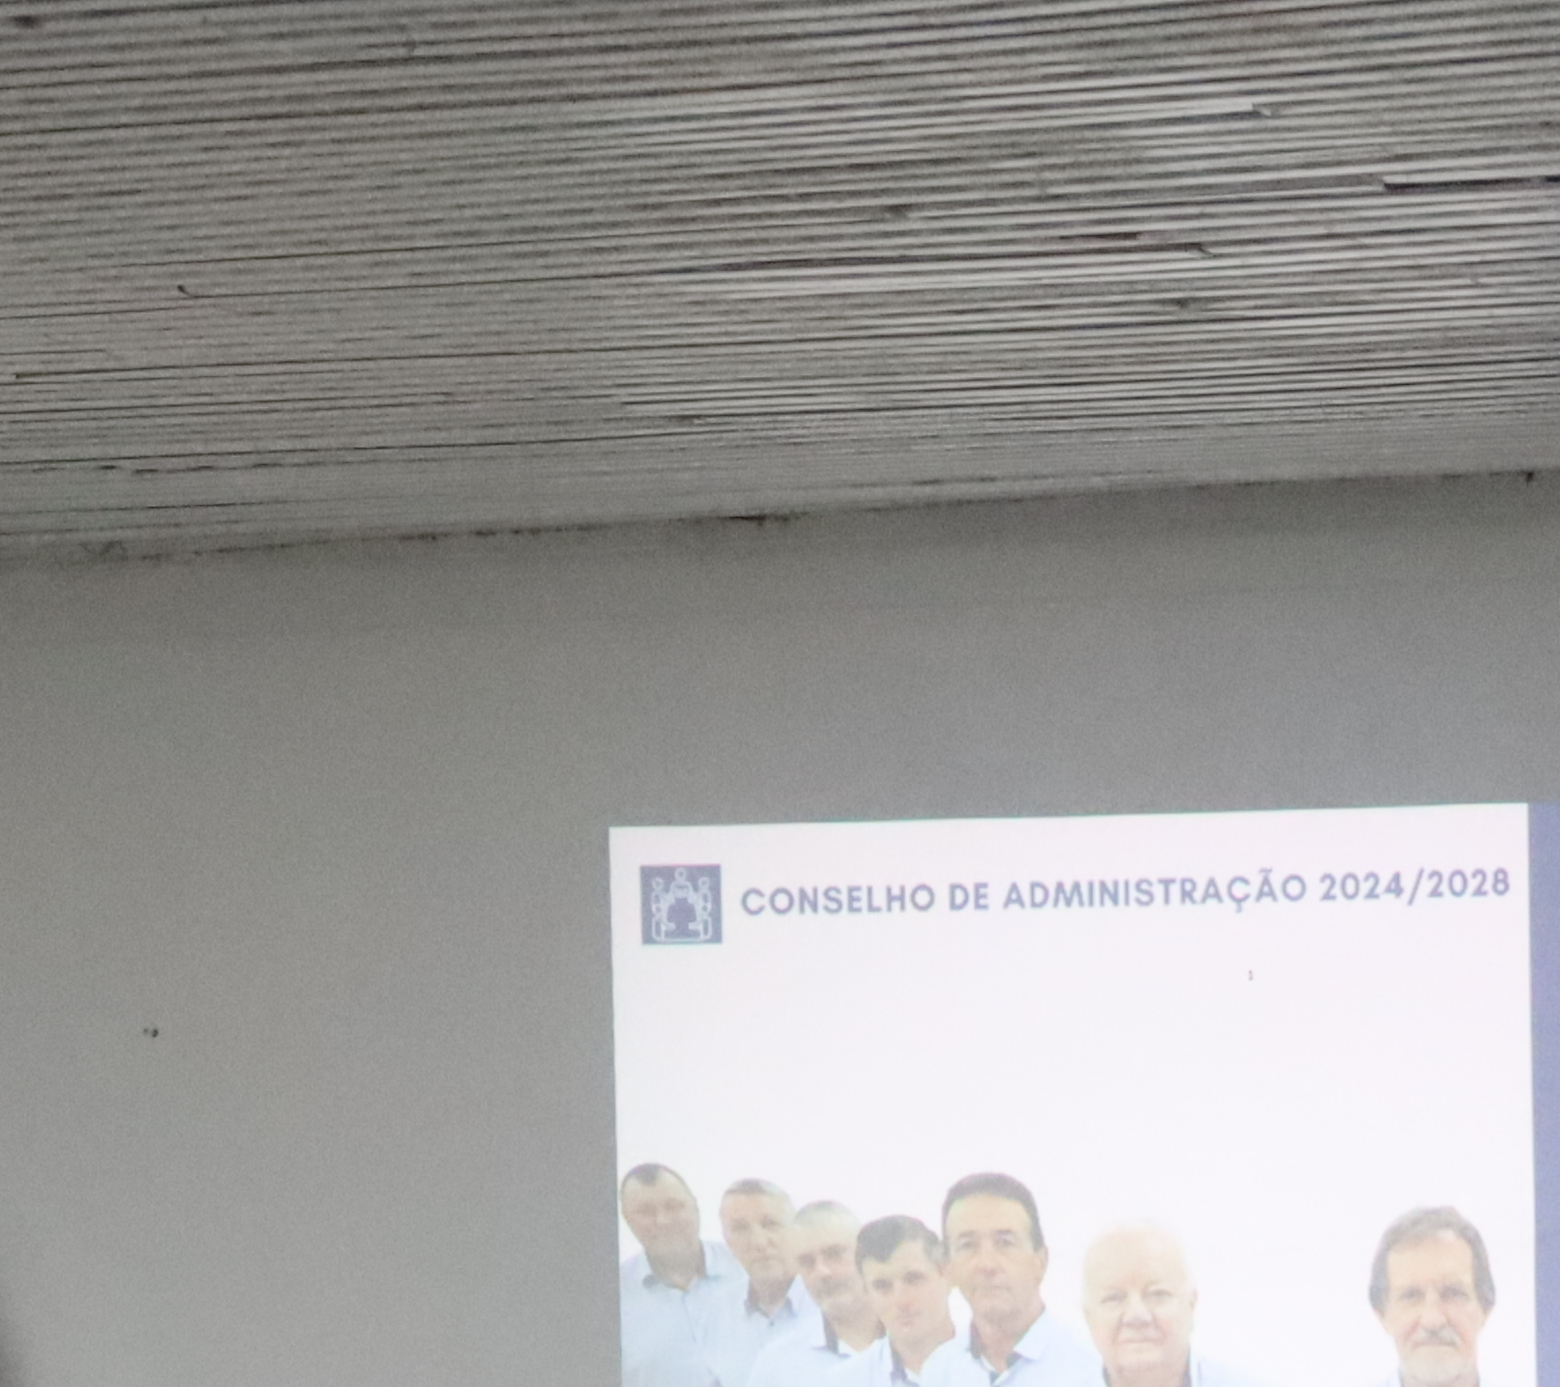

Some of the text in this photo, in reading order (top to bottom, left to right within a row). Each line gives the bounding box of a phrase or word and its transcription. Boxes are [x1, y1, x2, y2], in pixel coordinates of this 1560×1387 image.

[739, 867, 1512, 917] CONSELHO DE ADMINISTRAÇÃO 2024/2028
